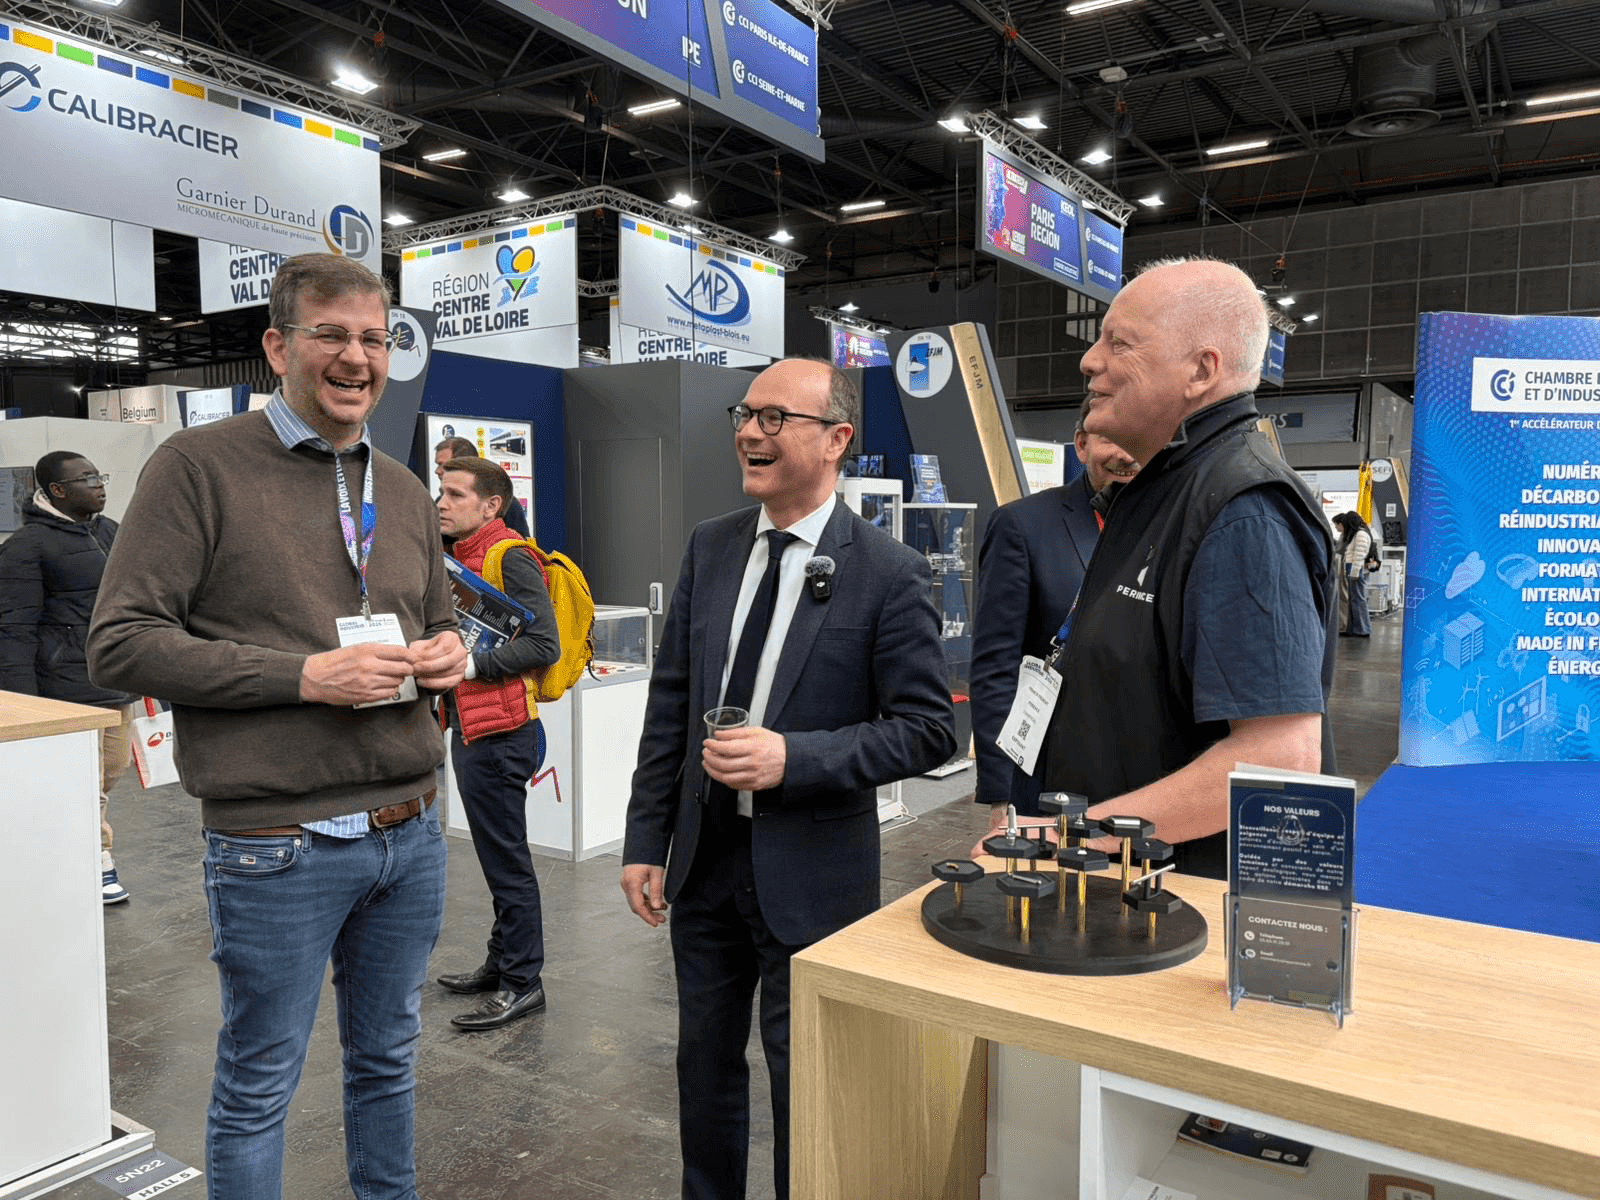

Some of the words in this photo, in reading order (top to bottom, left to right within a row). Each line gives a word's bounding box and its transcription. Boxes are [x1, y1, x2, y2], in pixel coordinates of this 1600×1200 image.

[750, 21, 768, 41] PARIS
[47, 88, 239, 160] CALIBRACIER
[177, 177, 247, 211] Garnier
[254, 195, 317, 228] Durand
[1031, 203, 1056, 229] PARIS
[261, 223, 270, 231] de
[1030, 221, 1060, 251] REGION
[231, 279, 258, 304] VAL
[432, 272, 489, 299] RÉGION
[433, 293, 490, 319] CENTRE
[434, 317, 461, 339] VAL
[463, 315, 482, 336] DE
[484, 308, 529, 332] LOIRE
[638, 337, 692, 355] CENTRE
[969, 355, 985, 390] EFJM
[1524, 371, 1593, 385] CHAMBRE
[1524, 388, 1541, 401] ET
[122, 407, 157, 421] Belgium
[1521, 417, 1594, 430] ACCÉLÉRATEUR
[1543, 459, 1600, 480] NUMÉR
[1521, 484, 1600, 505] DÉCARBO
[1537, 538, 1600, 554] INNOVA
[1521, 587, 1600, 602] INTERNAT
[1544, 607, 1600, 627] ÉCOLO
[1516, 636, 1563, 651] MADE
[1567, 636, 1585, 651] IN
[1548, 655, 1600, 675] ÉNERG
[1264, 805, 1282, 814] NOS
[1284, 806, 1320, 817] VALEURS
[1248, 916, 1298, 929] CONTACTEZ
[1299, 922, 1323, 933] NOUS
[114, 1159, 167, 1184] 5N22
[138, 1179, 180, 1198] HALL
[179, 1171, 191, 1179] 5
